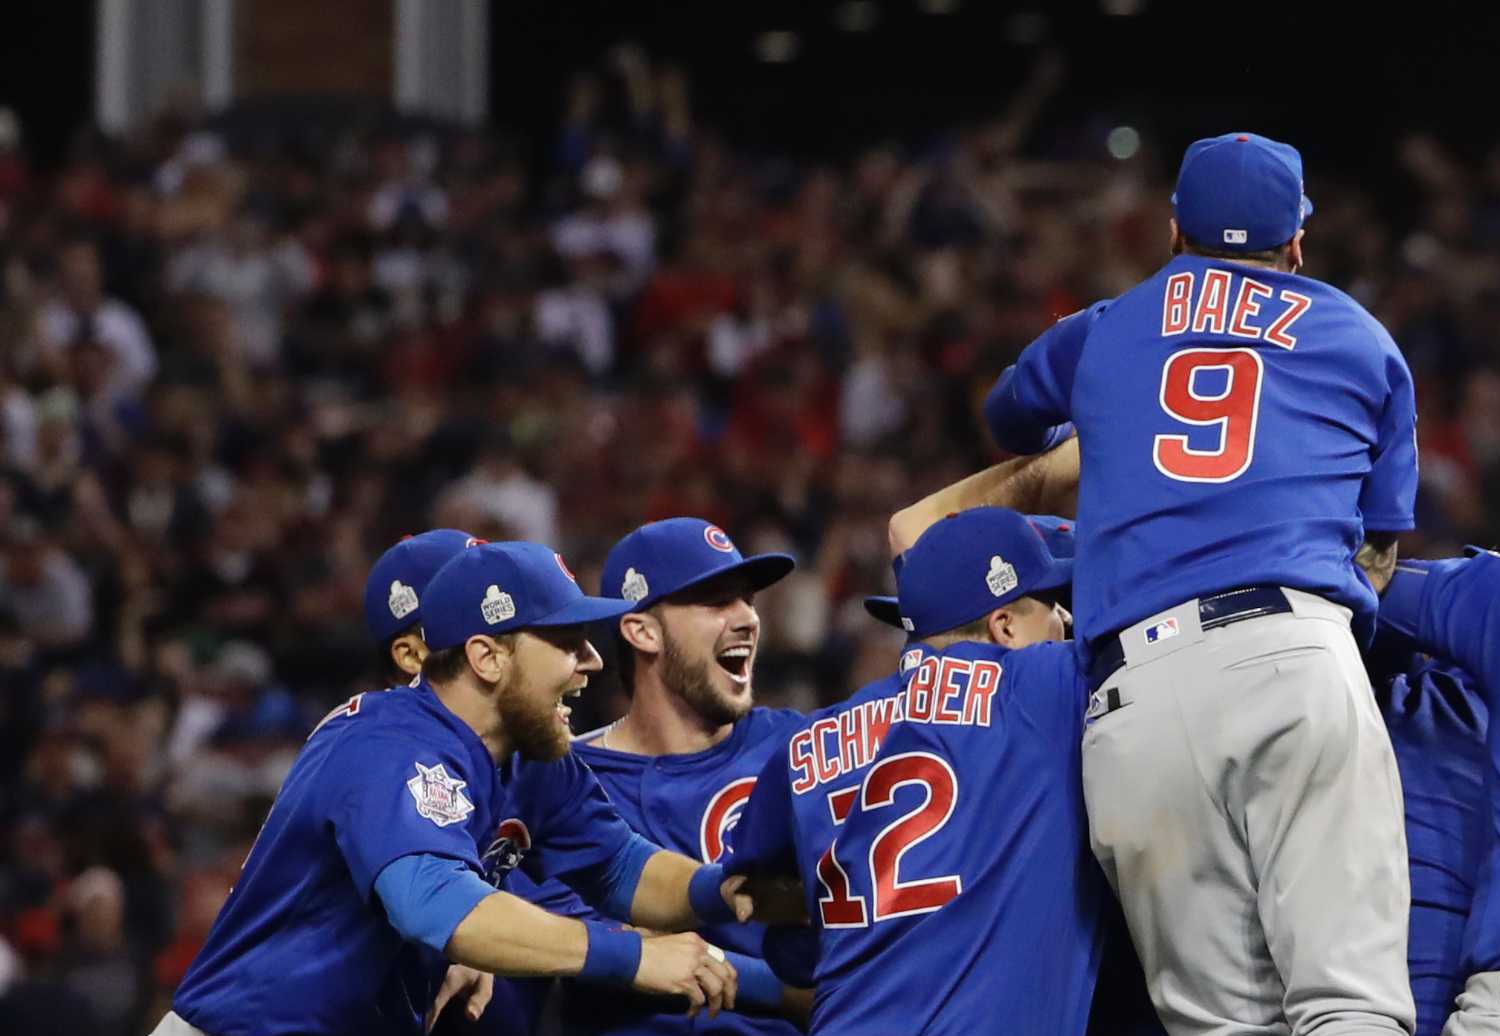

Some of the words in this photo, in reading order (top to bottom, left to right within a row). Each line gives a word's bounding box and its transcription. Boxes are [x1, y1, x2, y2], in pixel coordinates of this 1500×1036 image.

[1162, 269, 1312, 350] BAEZ
[1153, 348, 1264, 483] 9
[704, 525, 734, 552] C
[482, 597, 511, 610] WORLD
[789, 656, 1002, 795] SCHWBER
[818, 752, 962, 928] 12
